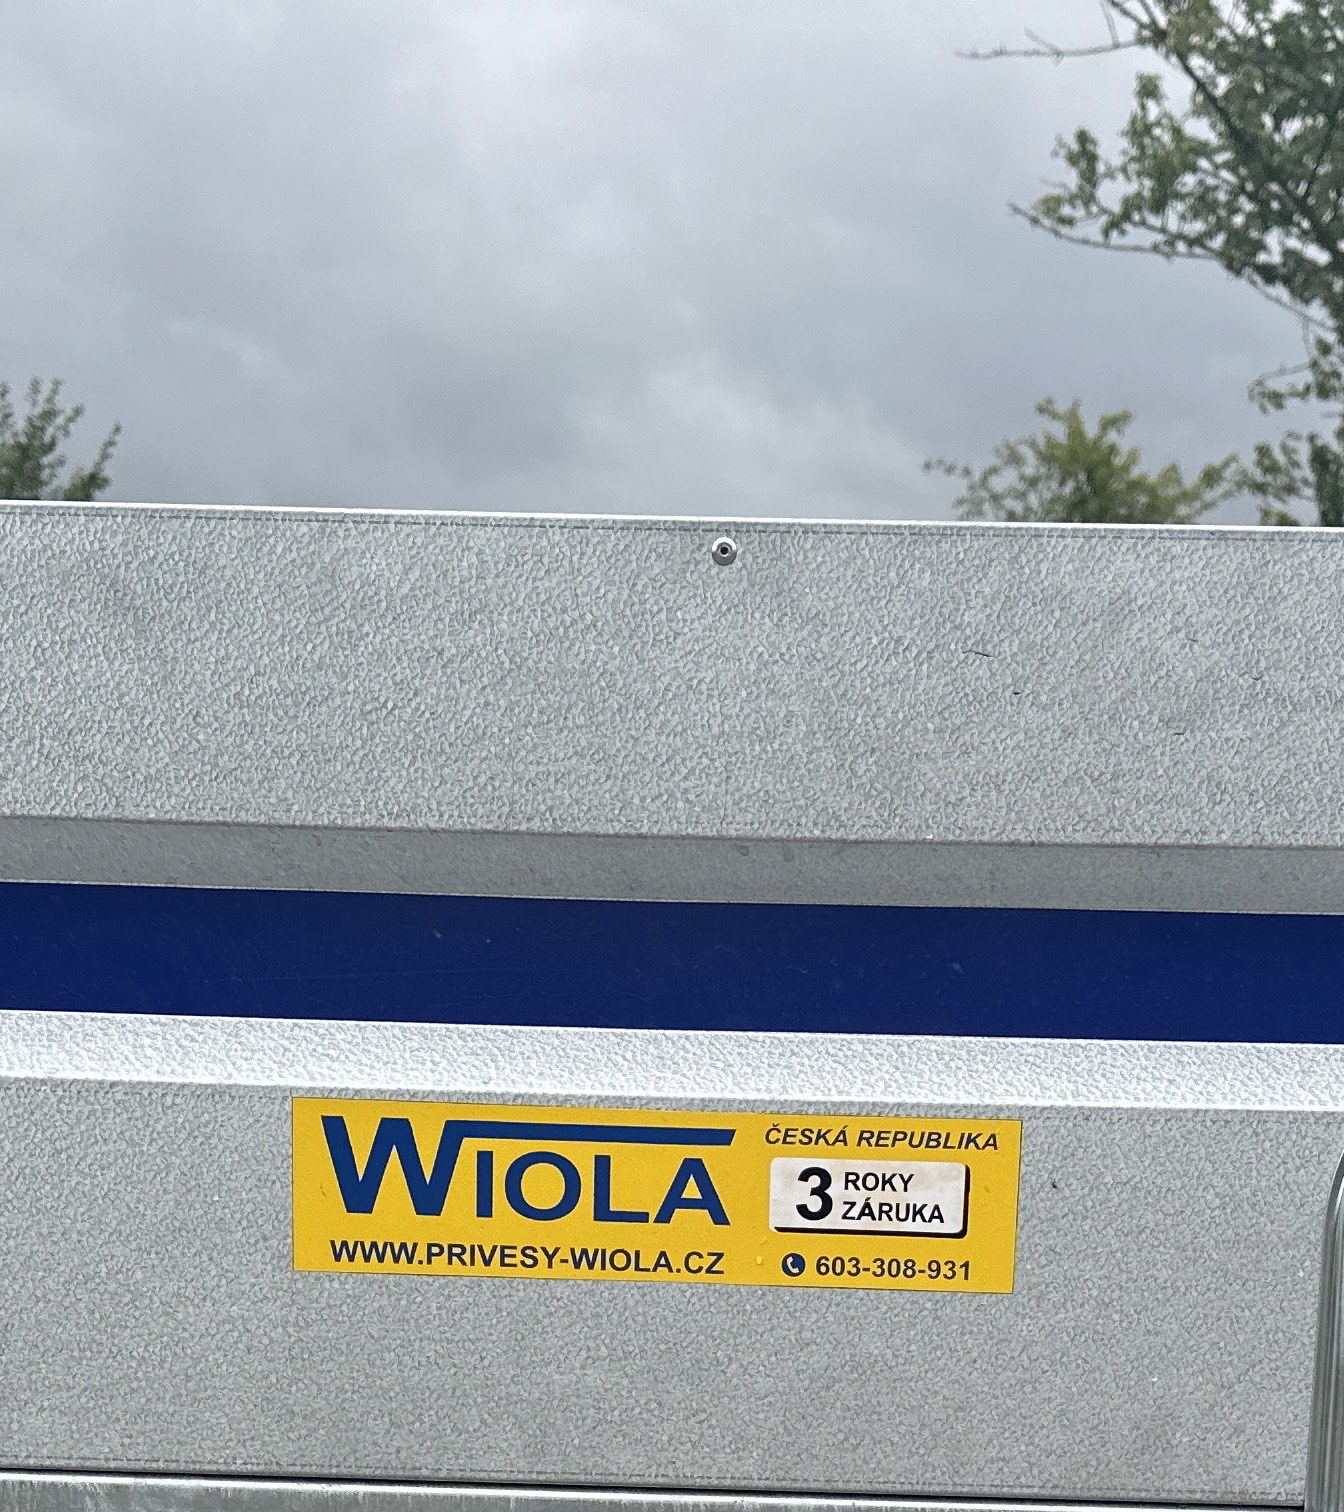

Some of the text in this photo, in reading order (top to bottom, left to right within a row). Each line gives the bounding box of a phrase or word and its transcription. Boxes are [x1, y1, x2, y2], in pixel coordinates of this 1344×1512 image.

[765, 1123, 999, 1151] ČESKÁ REPUBLIKA
[320, 1115, 737, 1226] WIOLA
[796, 1166, 915, 1221] 3 ROKY
[841, 1197, 945, 1224] ZÁRUKA
[329, 1240, 725, 1275] WWW.PRIVESY-WIOLA.CZ
[815, 1256, 970, 1281] 603-308-931
